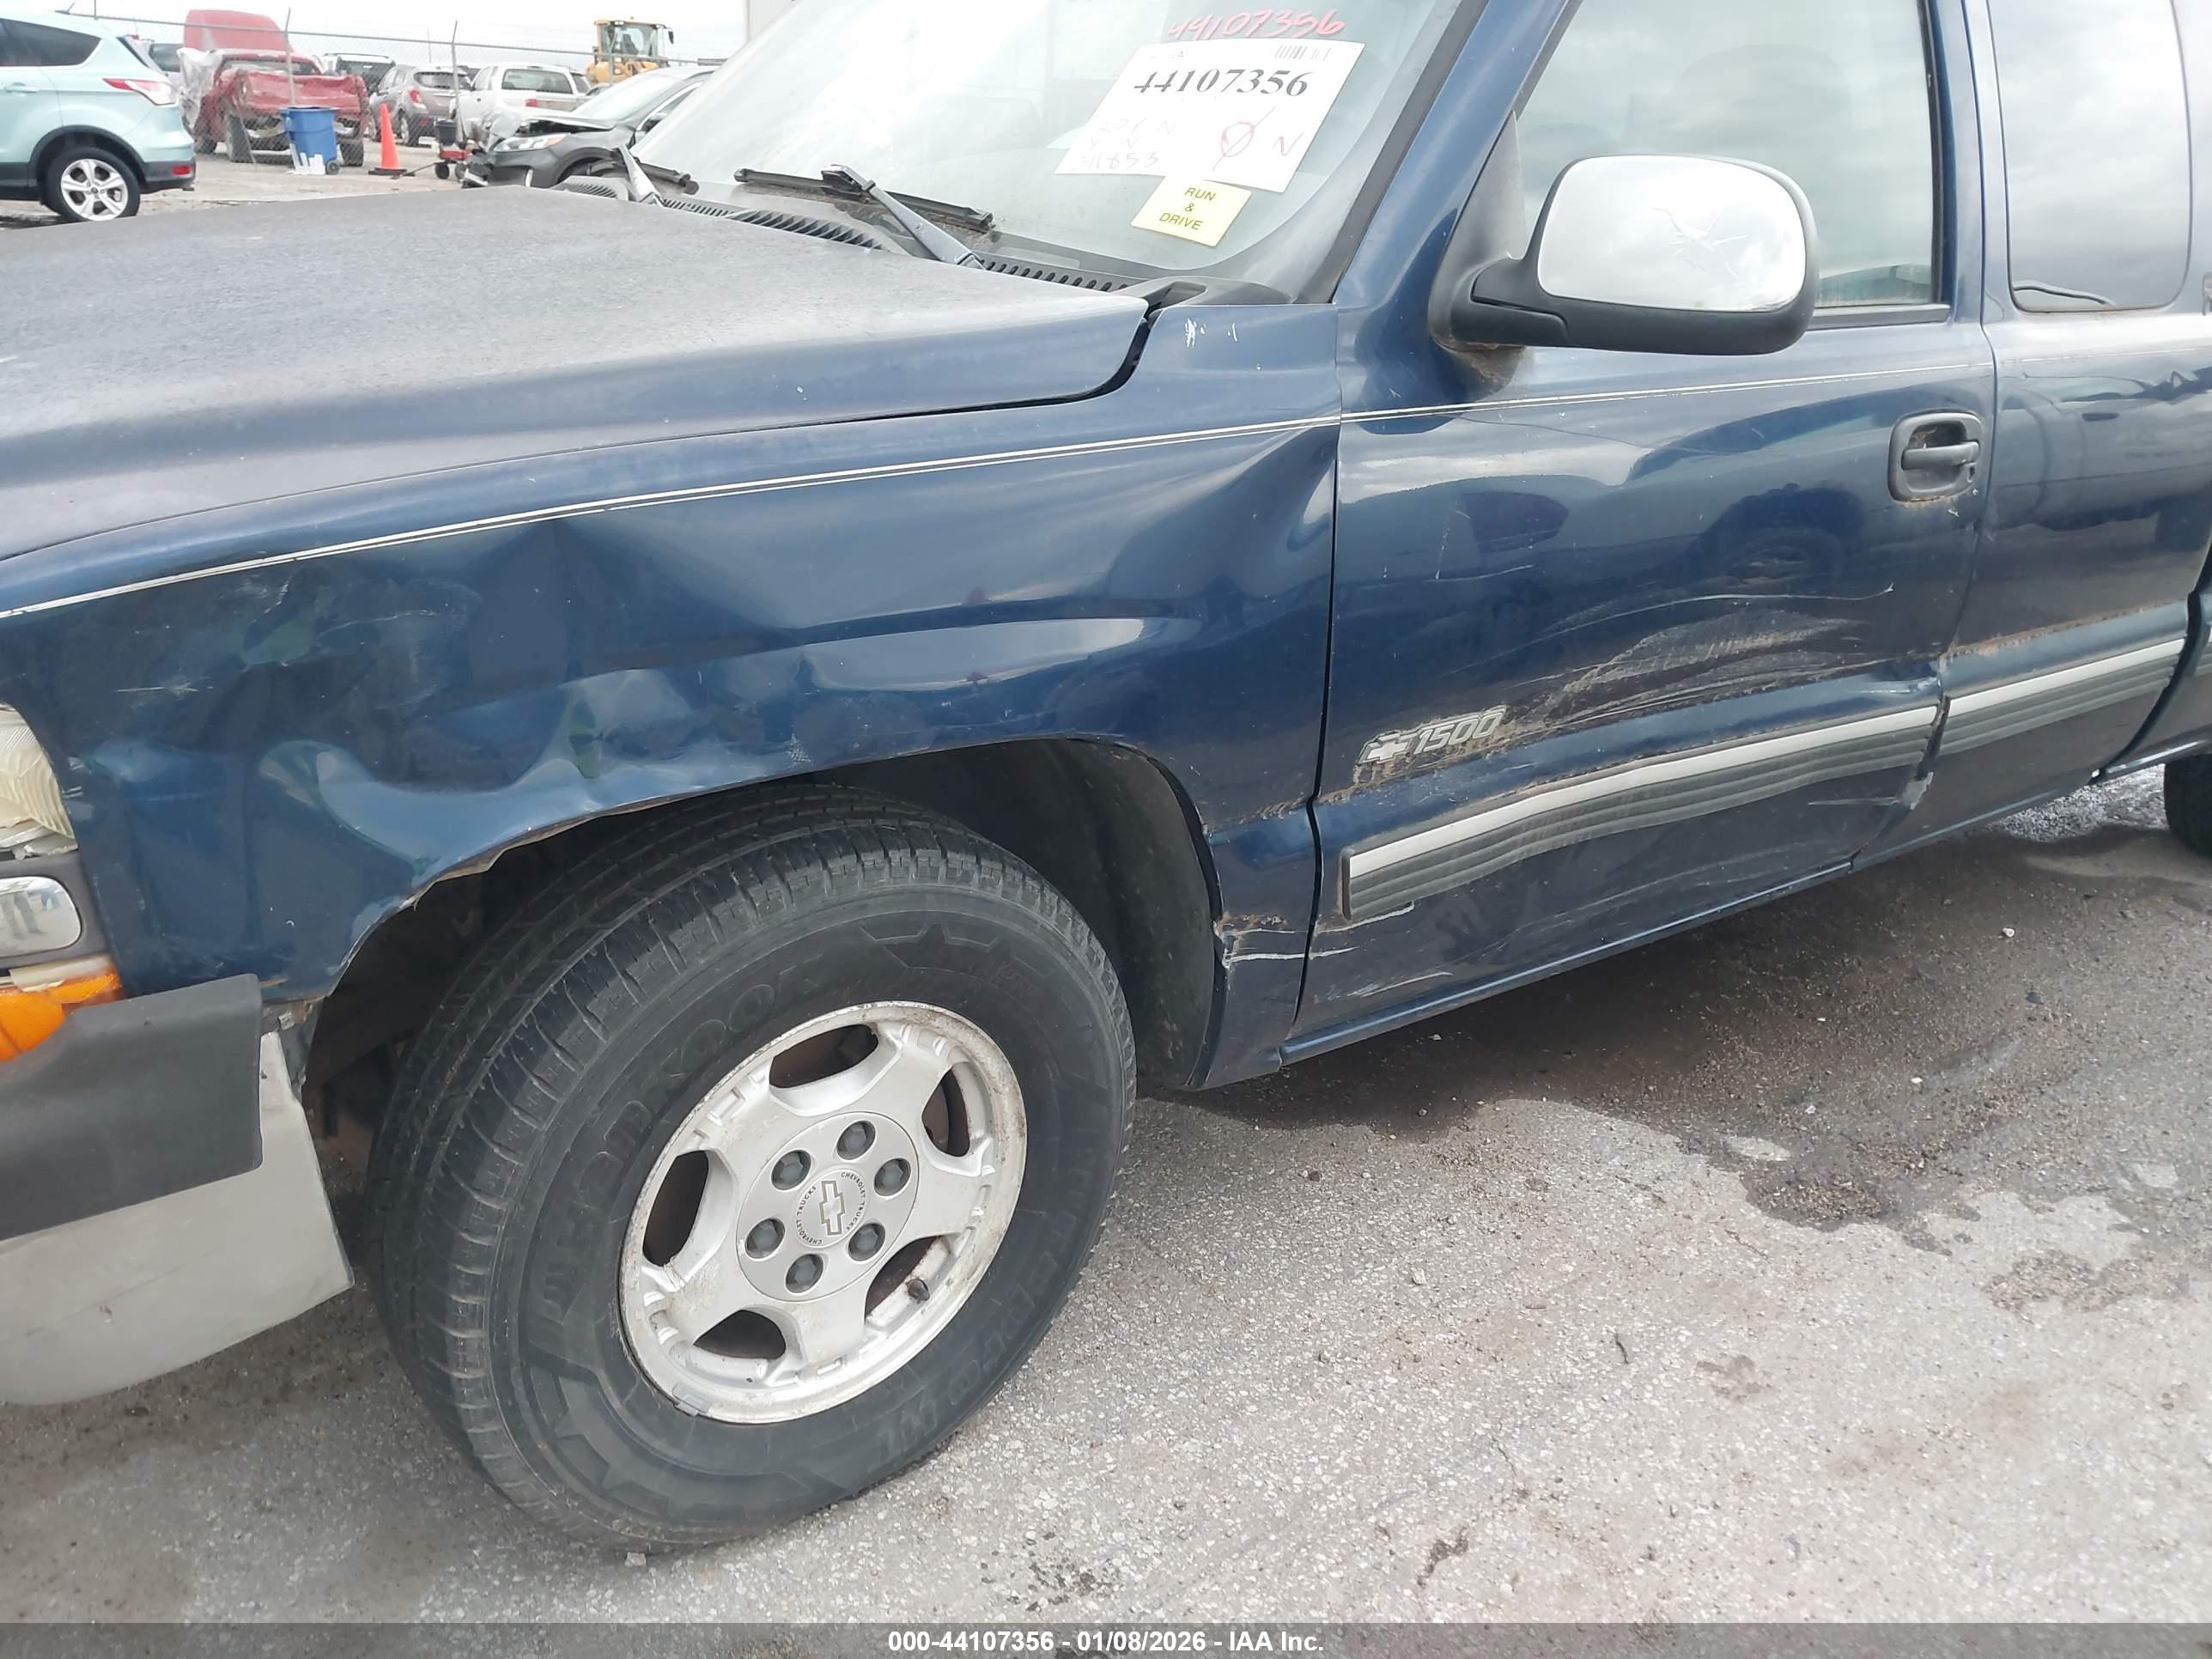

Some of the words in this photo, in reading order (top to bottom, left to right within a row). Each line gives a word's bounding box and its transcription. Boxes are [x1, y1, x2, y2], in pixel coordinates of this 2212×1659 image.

[1168, 8, 1346, 40] 44107356
[1133, 68, 1315, 97] 44107356
[1184, 186, 1217, 202] RUN
[1184, 202, 1195, 213] &
[1158, 211, 1203, 231] DRIVE
[1413, 704, 1507, 755] 1500
[841, 1172, 866, 1198] CHEVROLET
[796, 1186, 817, 1217] TRUCKS
[796, 1219, 823, 1245] CHEVROLET
